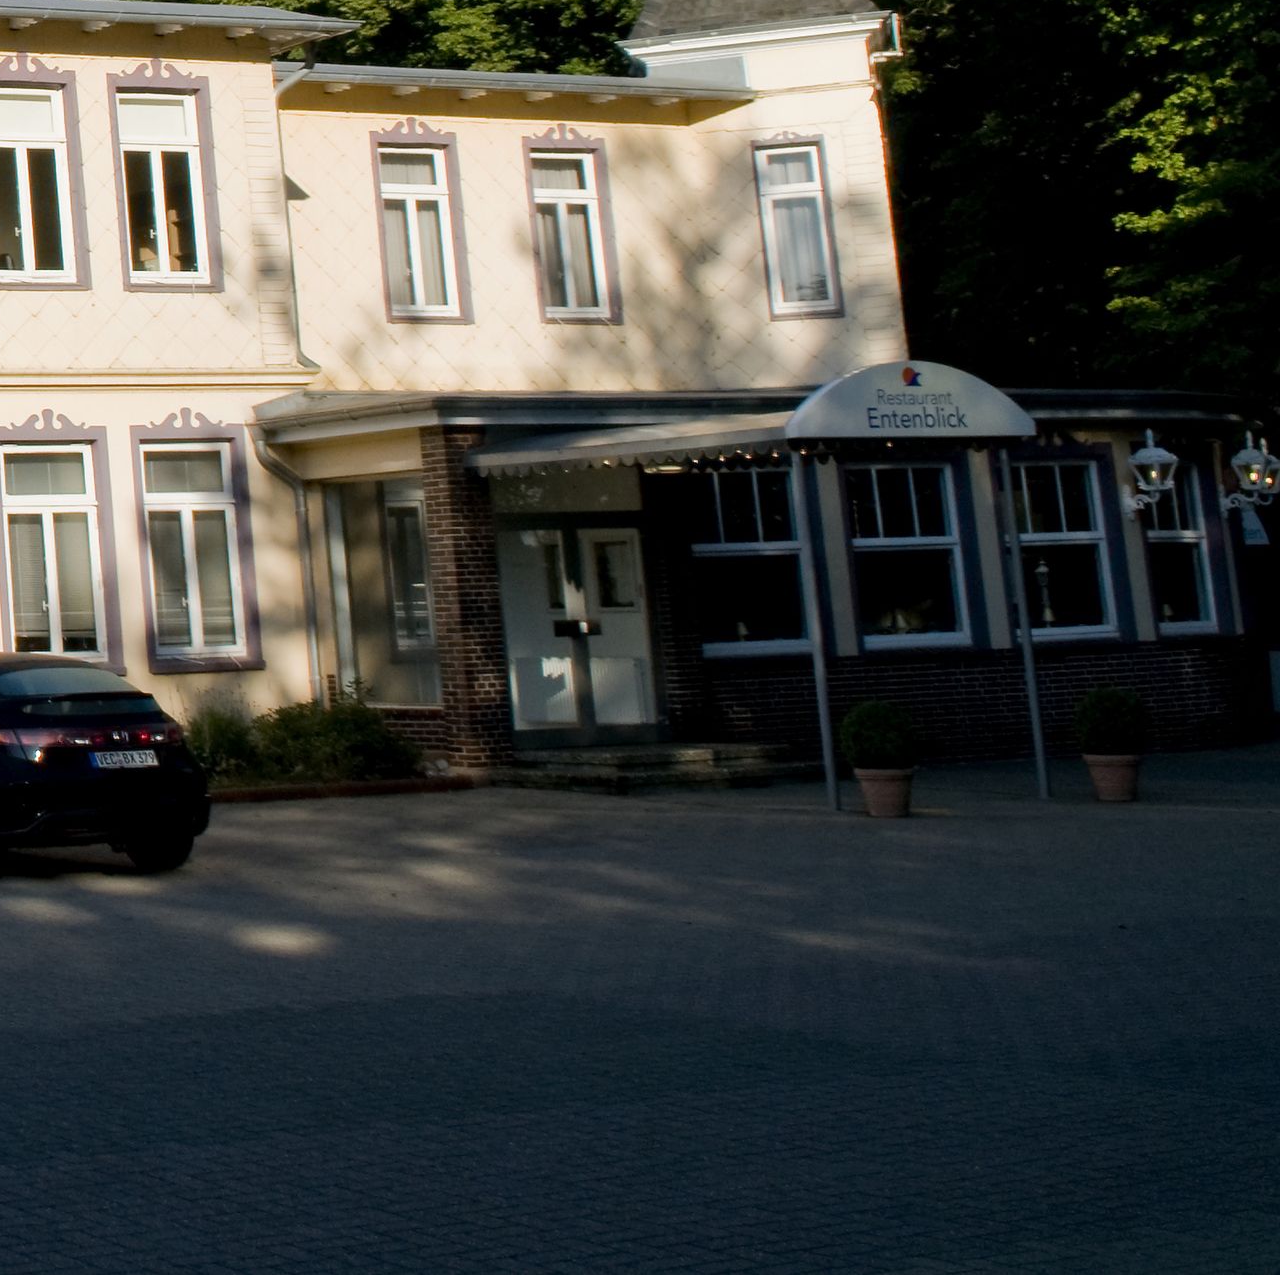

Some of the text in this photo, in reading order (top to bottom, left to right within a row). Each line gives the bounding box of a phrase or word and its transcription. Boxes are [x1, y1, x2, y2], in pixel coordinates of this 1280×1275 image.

[876, 389, 953, 405] Restaurant
[867, 406, 968, 429] Entenblick
[97, 753, 117, 765] VEC
